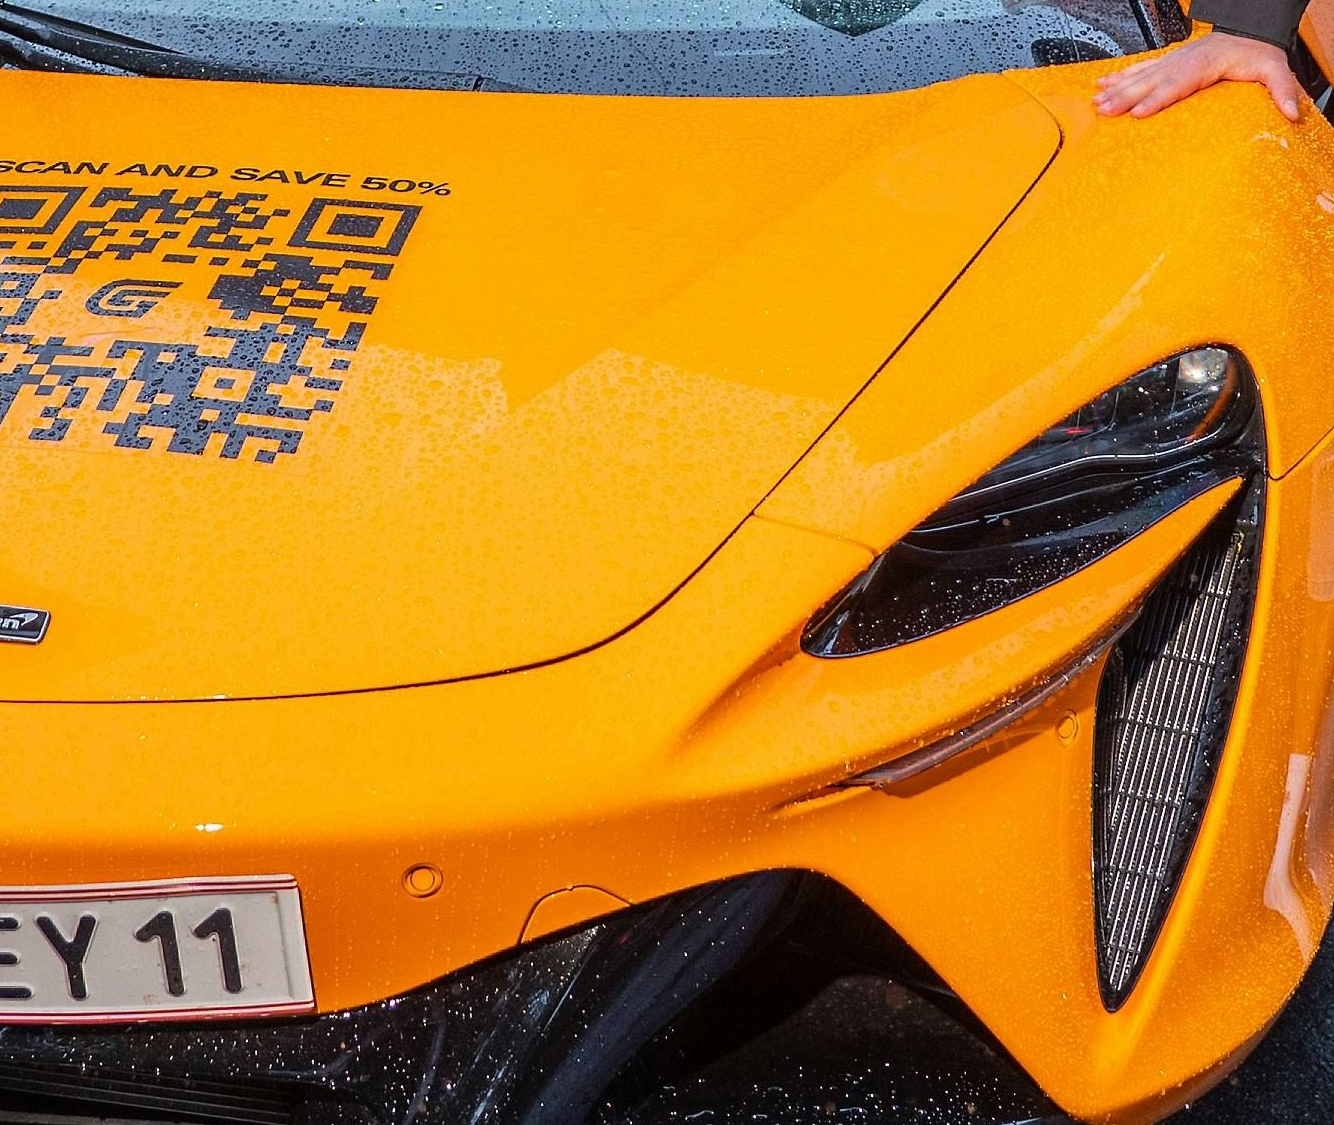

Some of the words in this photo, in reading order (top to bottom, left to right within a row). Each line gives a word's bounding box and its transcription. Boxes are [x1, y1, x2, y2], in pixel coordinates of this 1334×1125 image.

[116, 161, 219, 179] AND
[230, 167, 351, 189] SAVE
[360, 176, 452, 197] 50%
[133, 906, 243, 997] 11
